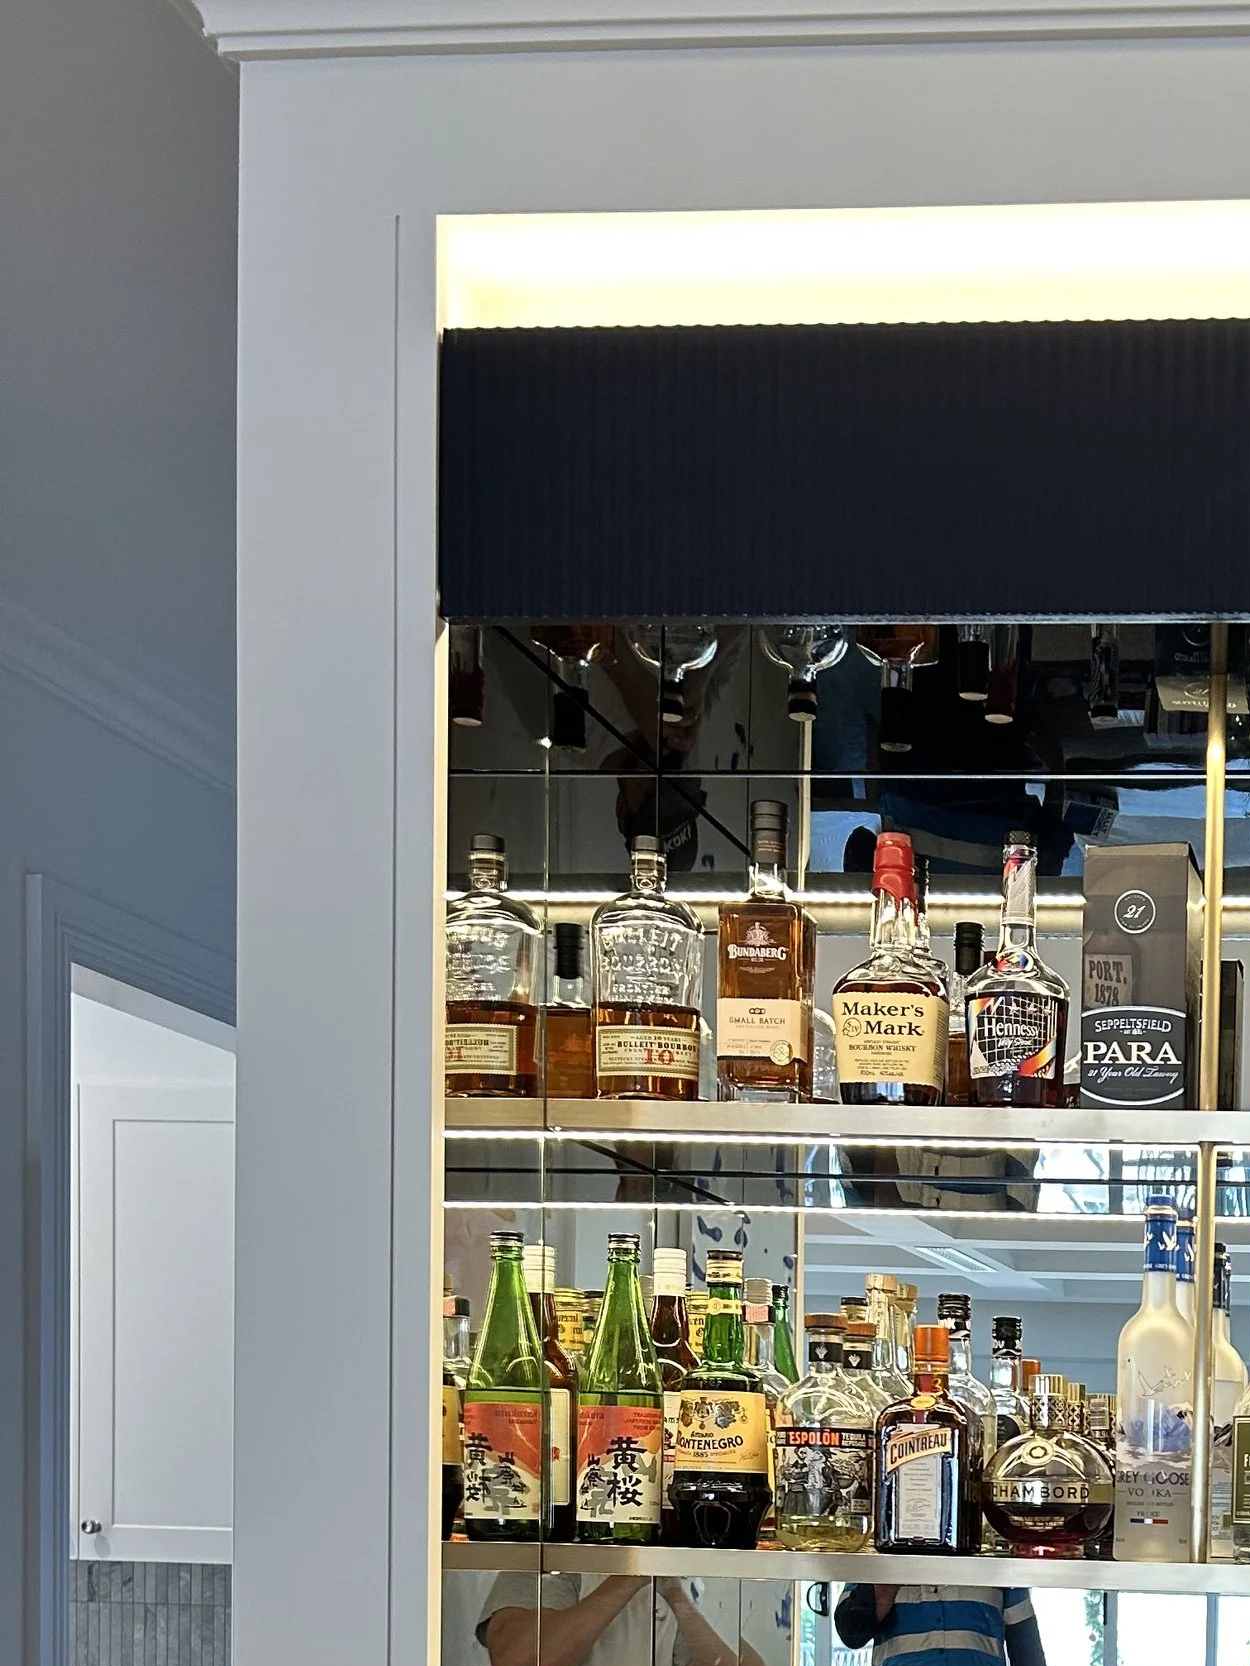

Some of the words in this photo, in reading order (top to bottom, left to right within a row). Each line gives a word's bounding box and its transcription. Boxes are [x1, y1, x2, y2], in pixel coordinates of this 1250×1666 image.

[1122, 904, 1146, 919] 21
[727, 945, 787, 961] BUNDABERG
[1088, 960, 1127, 985] PORT.
[1094, 983, 1120, 1007] 1878
[841, 1001, 925, 1018] Maker's
[729, 1016, 756, 1025] SMALL
[759, 1016, 786, 1025] BATCH
[864, 1020, 924, 1037] Mark
[983, 1018, 1040, 1038] Hennessy
[1094, 1018, 1172, 1033] SEPPELTSFIELD
[1083, 1041, 1182, 1065] PARA
[1098, 1067, 1122, 1084] Year
[1123, 1066, 1143, 1078] Old
[1143, 1066, 1179, 1084] Tawny
[890, 1432, 947, 1465] COINTREAU
[991, 1484, 1090, 1500] CHAMBORD
[1128, 1488, 1172, 1498] VOKA
